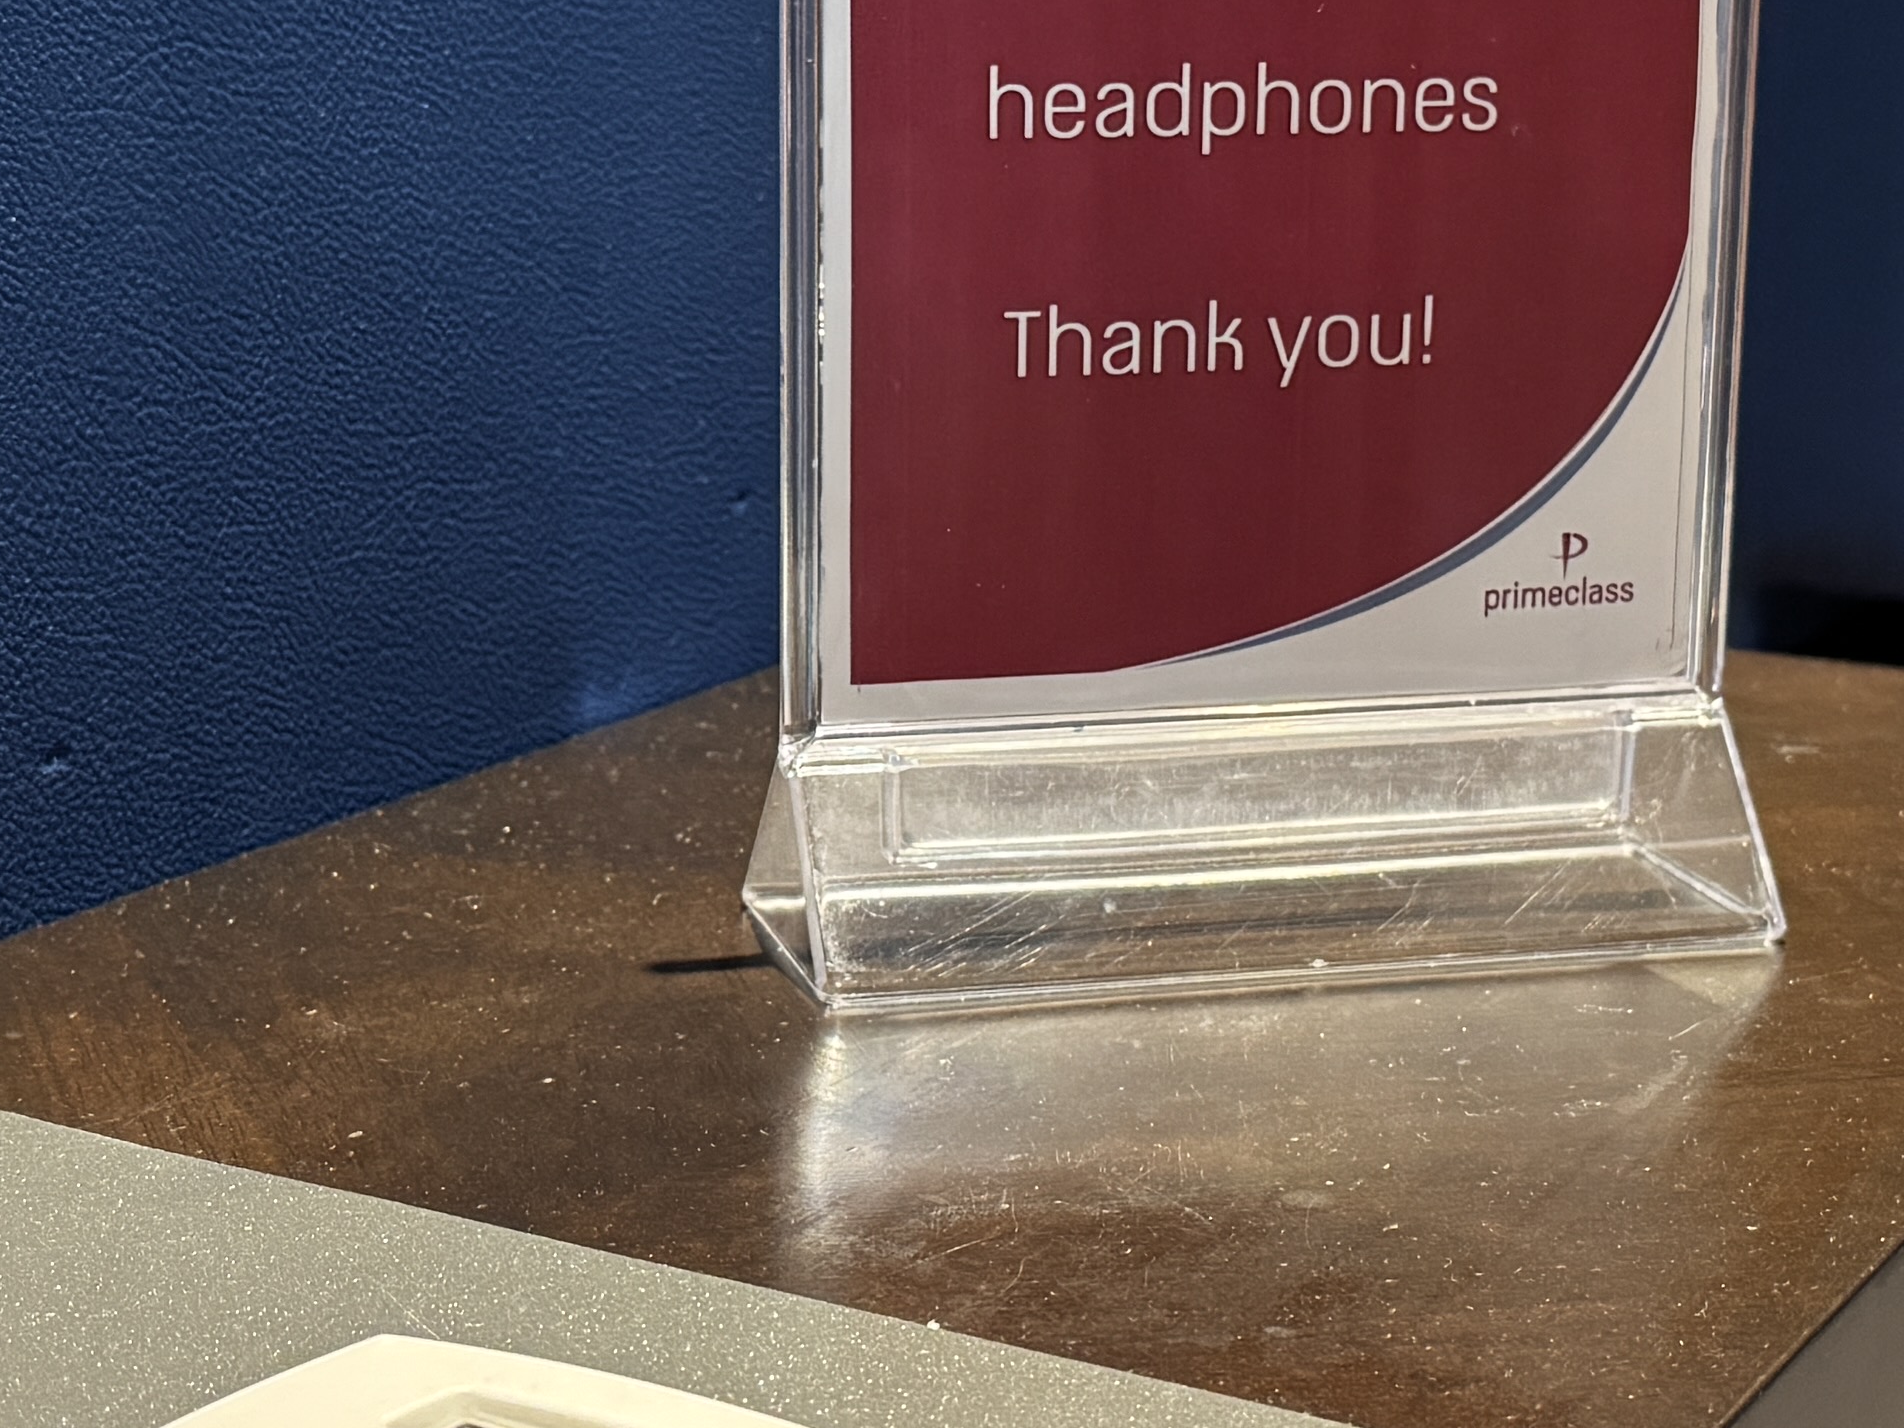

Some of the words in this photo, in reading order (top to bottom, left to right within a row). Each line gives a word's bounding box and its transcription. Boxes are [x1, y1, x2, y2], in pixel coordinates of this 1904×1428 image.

[988, 60, 1499, 157] headphones
[1002, 298, 1245, 379] Thank
[1266, 293, 1437, 389] you!
[1483, 575, 1635, 618] primeclass
